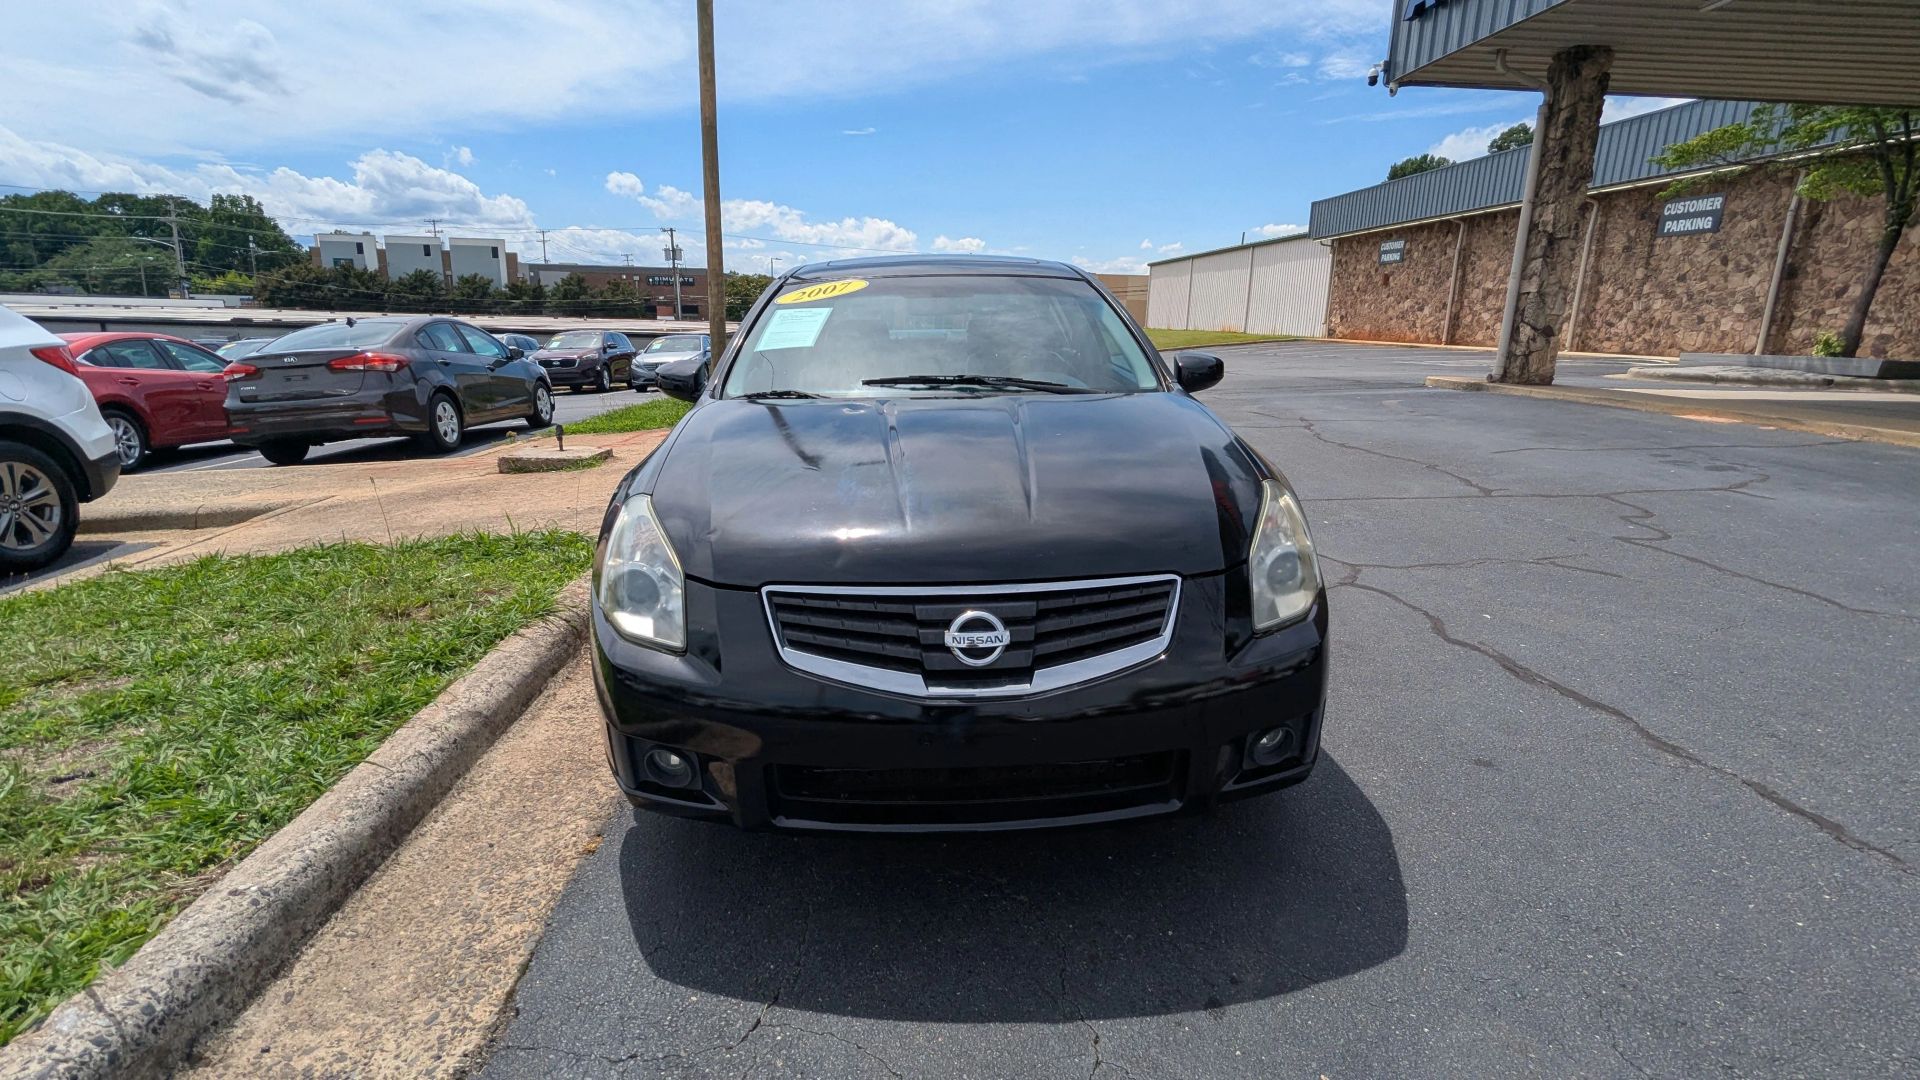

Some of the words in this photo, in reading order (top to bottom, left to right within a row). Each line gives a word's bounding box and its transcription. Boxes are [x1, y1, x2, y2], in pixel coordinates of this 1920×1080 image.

[1664, 196, 1723, 216] CUSTOMER
[1663, 216, 1713, 233] PARKING
[1380, 240, 1405, 251] CUSTOMER
[1380, 252, 1401, 262] PARKING
[791, 281, 852, 301] 2007
[951, 635, 1004, 645] NISSAN
